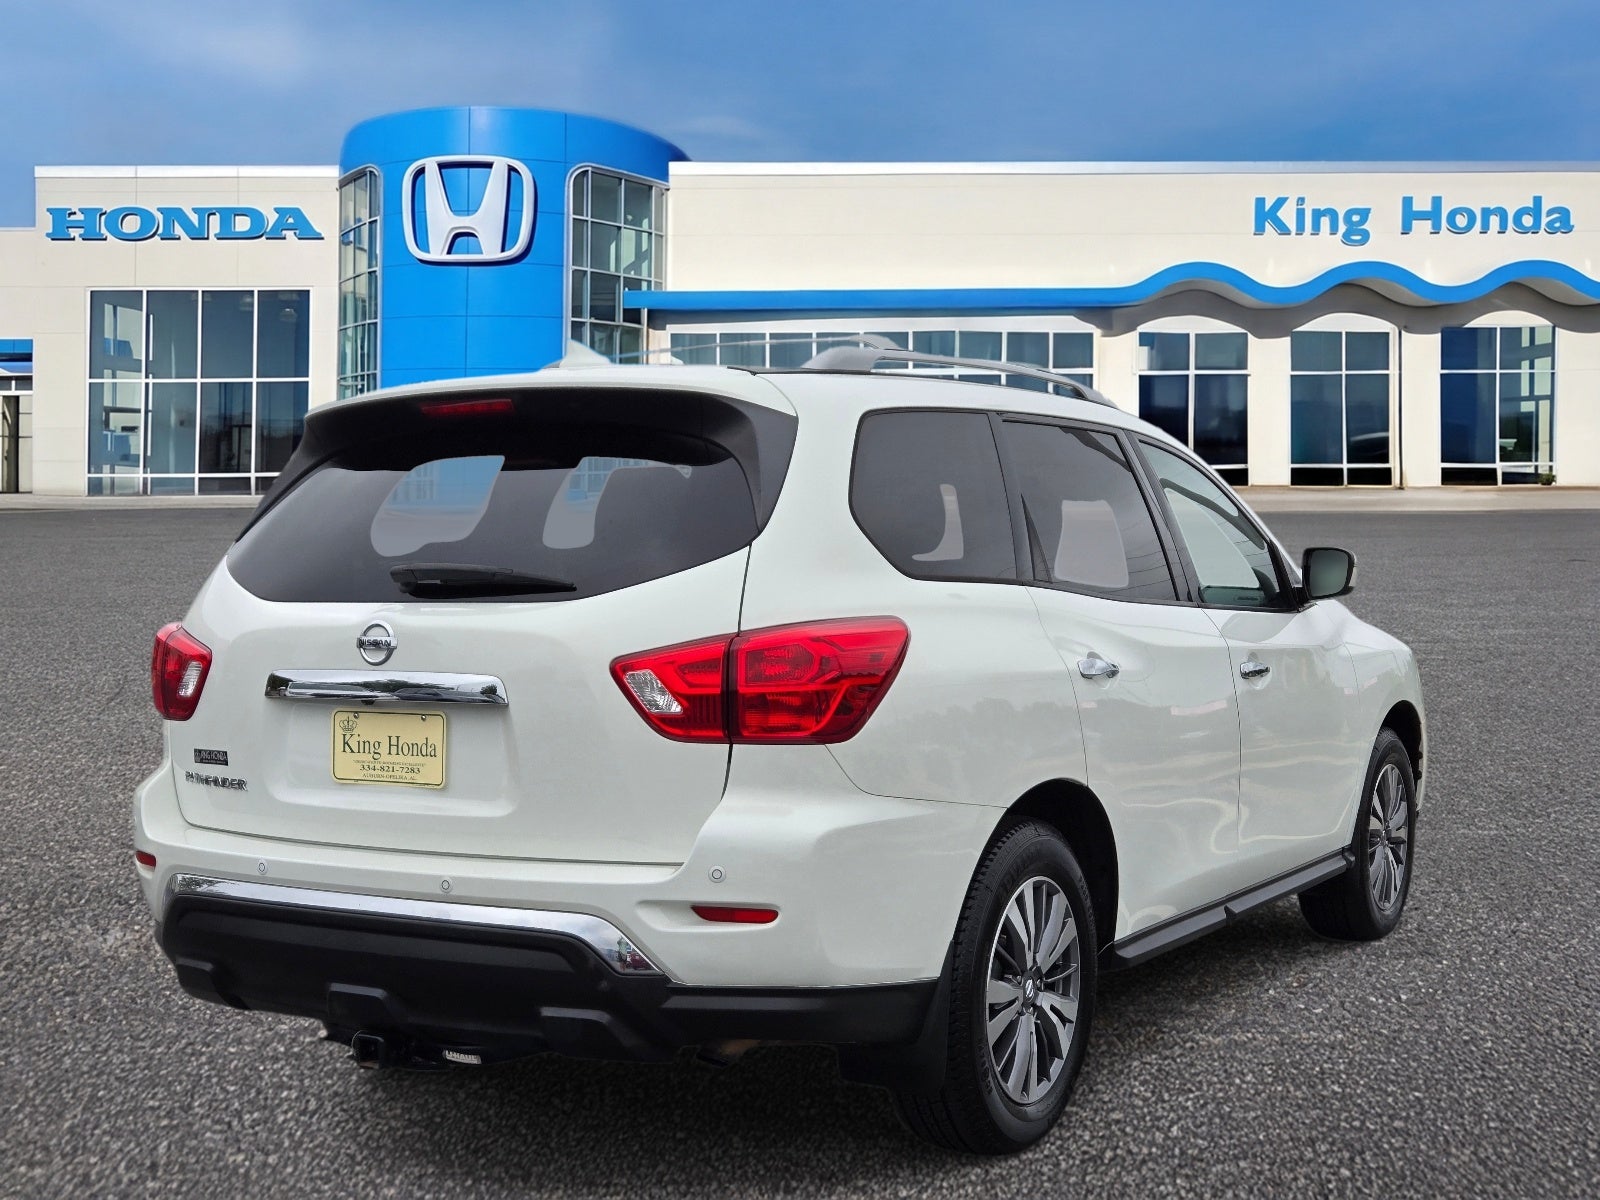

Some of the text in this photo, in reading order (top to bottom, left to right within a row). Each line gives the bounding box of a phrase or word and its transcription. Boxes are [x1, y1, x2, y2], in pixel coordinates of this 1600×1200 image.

[46, 206, 324, 241] HONDA
[1253, 195, 1574, 246] King Honda
[358, 638, 392, 648] NISSAN
[341, 733, 437, 760] King Honda
[359, 764, 421, 774] 334-821-7283
[185, 771, 248, 791] PATHFINDER
